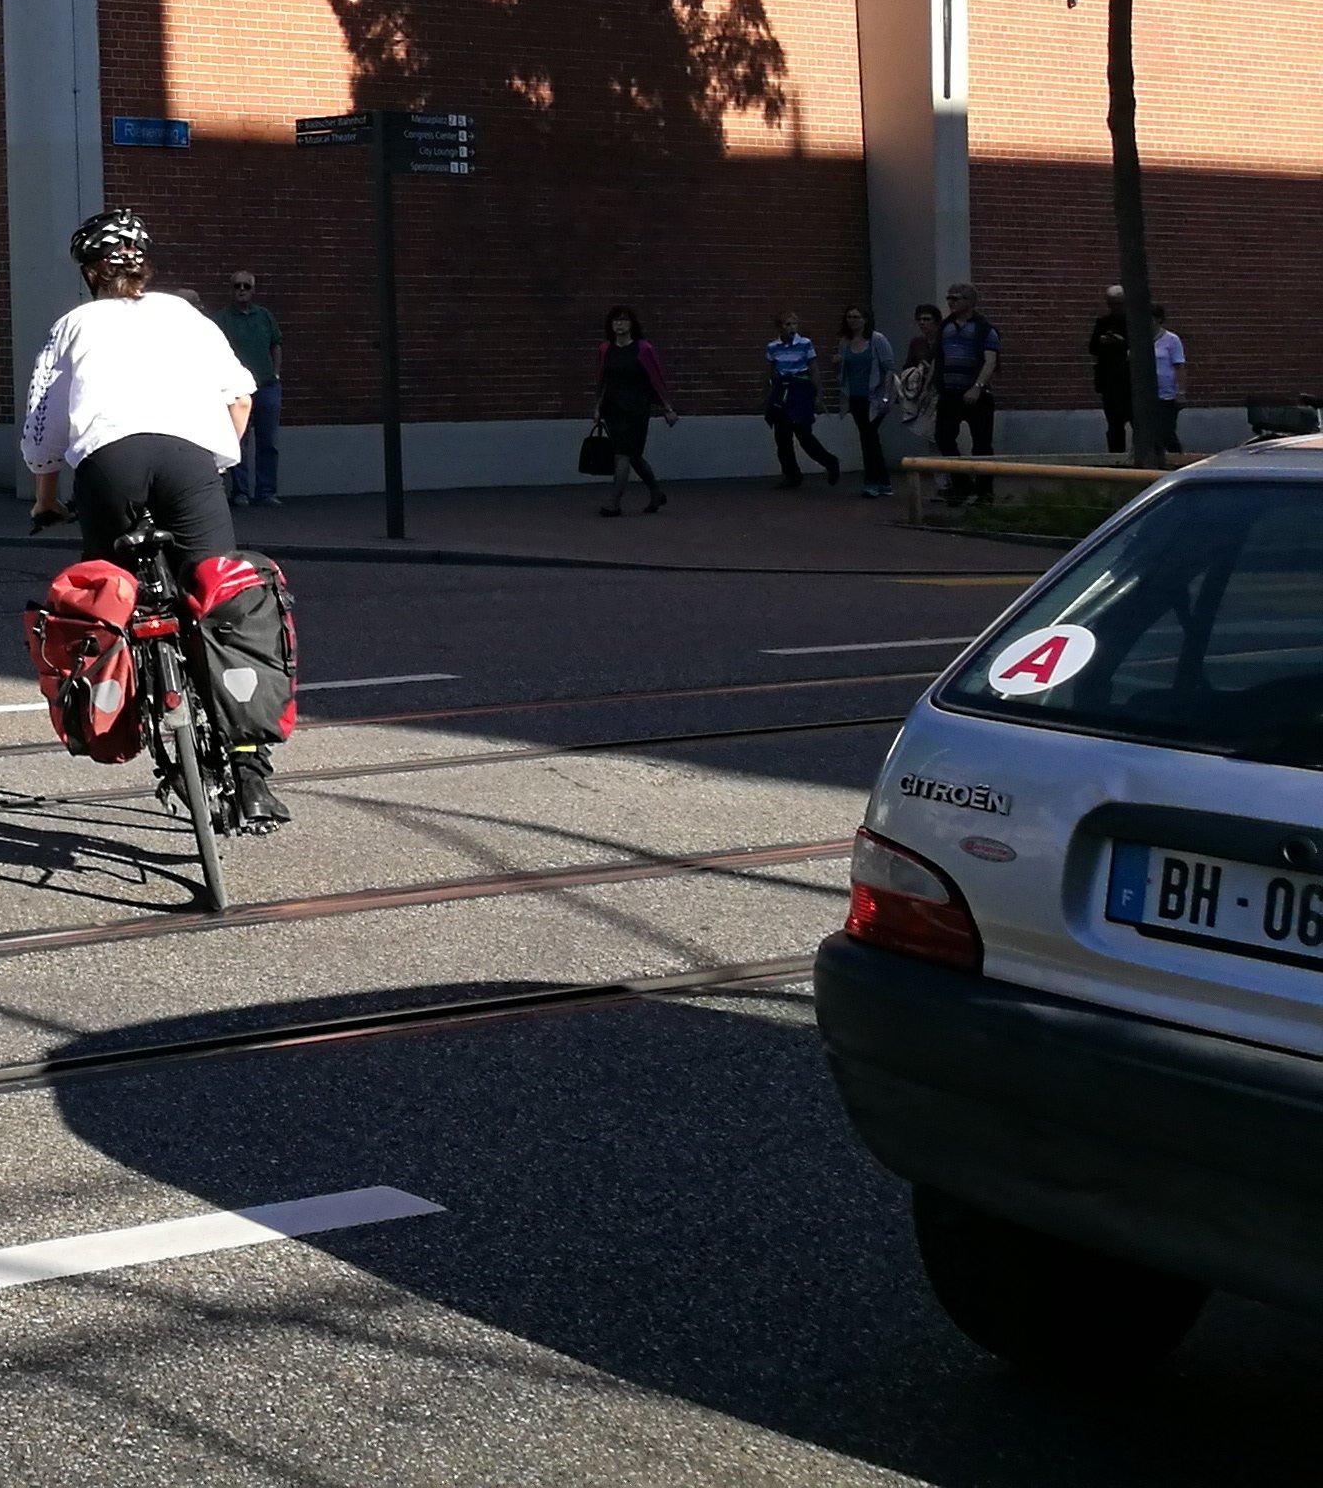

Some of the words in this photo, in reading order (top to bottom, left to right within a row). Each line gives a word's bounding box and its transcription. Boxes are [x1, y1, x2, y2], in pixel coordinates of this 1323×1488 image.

[998, 635, 1070, 684] A
[899, 773, 1012, 816] CITROËN
[1120, 888, 1134, 906] F
